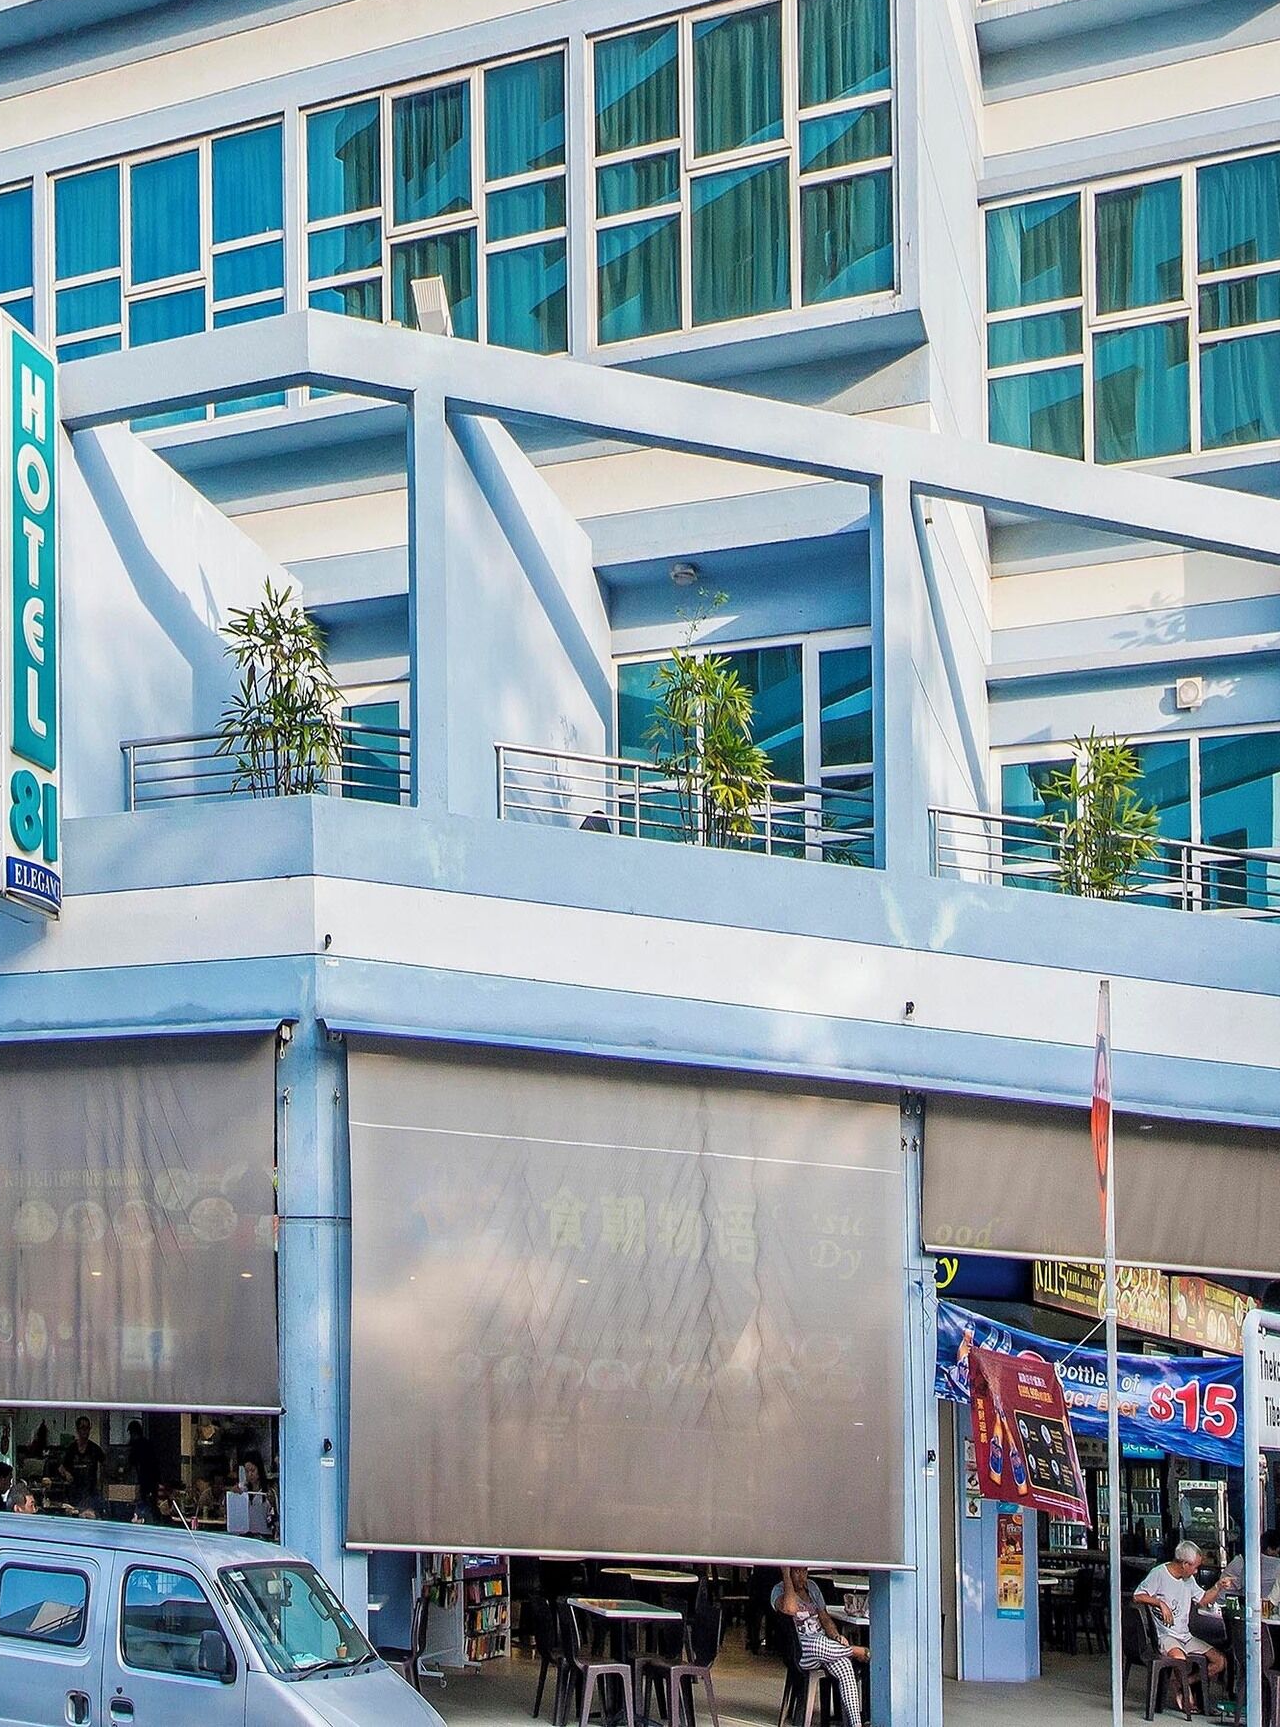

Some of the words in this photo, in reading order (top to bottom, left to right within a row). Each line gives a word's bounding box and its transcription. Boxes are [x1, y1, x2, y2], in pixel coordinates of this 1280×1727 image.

[16, 361, 50, 739] HOTEL
[10, 770, 56, 862] 81
[1055, 1361, 1109, 1387] bottle
[1121, 1373, 1140, 1392] of
[1097, 1392, 1139, 1417] Ber
[1148, 1380, 1237, 1439] $15
